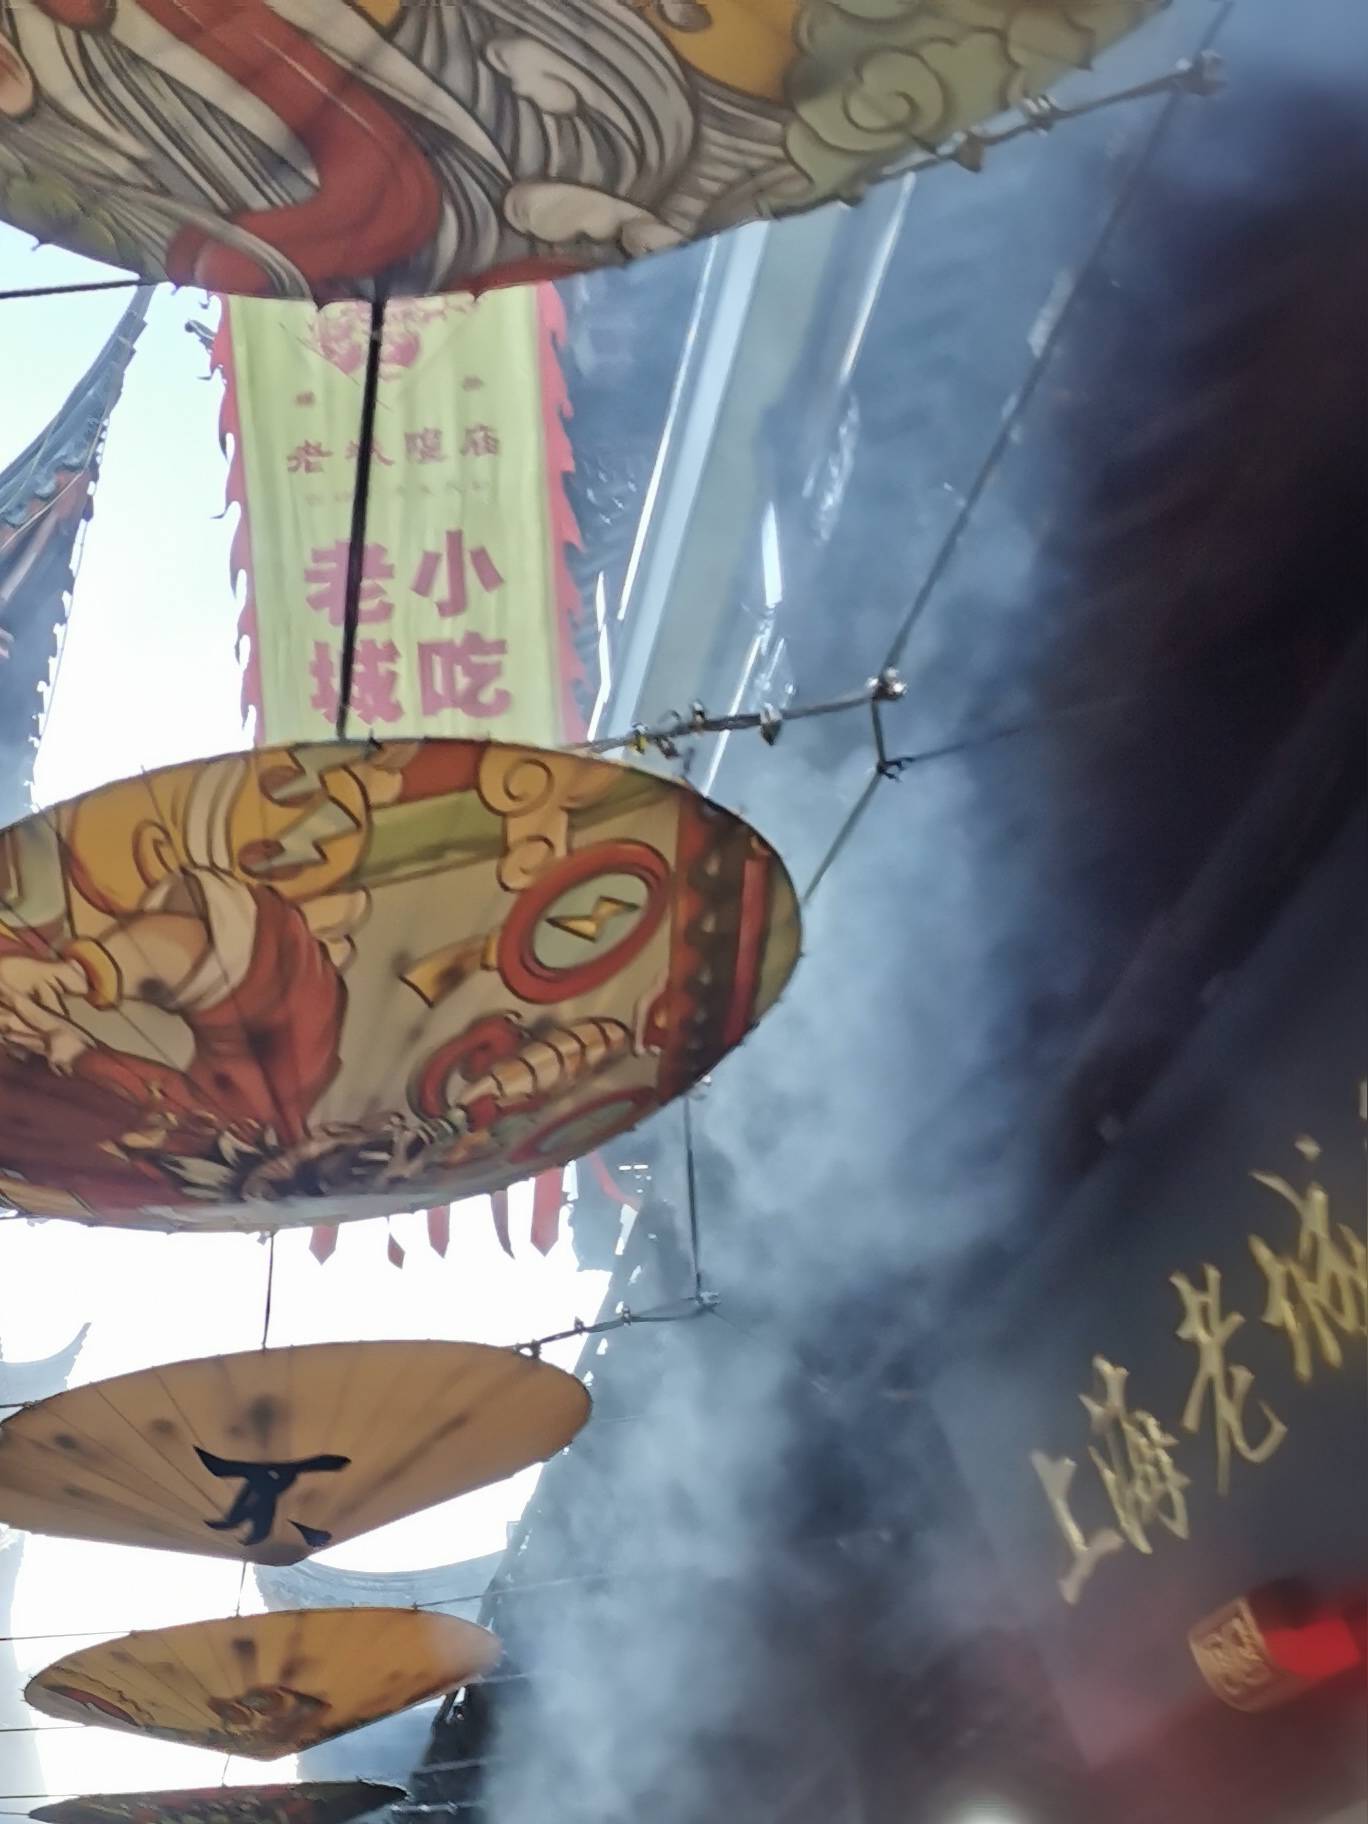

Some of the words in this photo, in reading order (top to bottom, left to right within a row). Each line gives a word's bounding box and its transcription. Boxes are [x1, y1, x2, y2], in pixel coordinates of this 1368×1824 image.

[409, 529, 513, 719] 小吃
[1031, 1081, 1368, 1605] 上海老城
